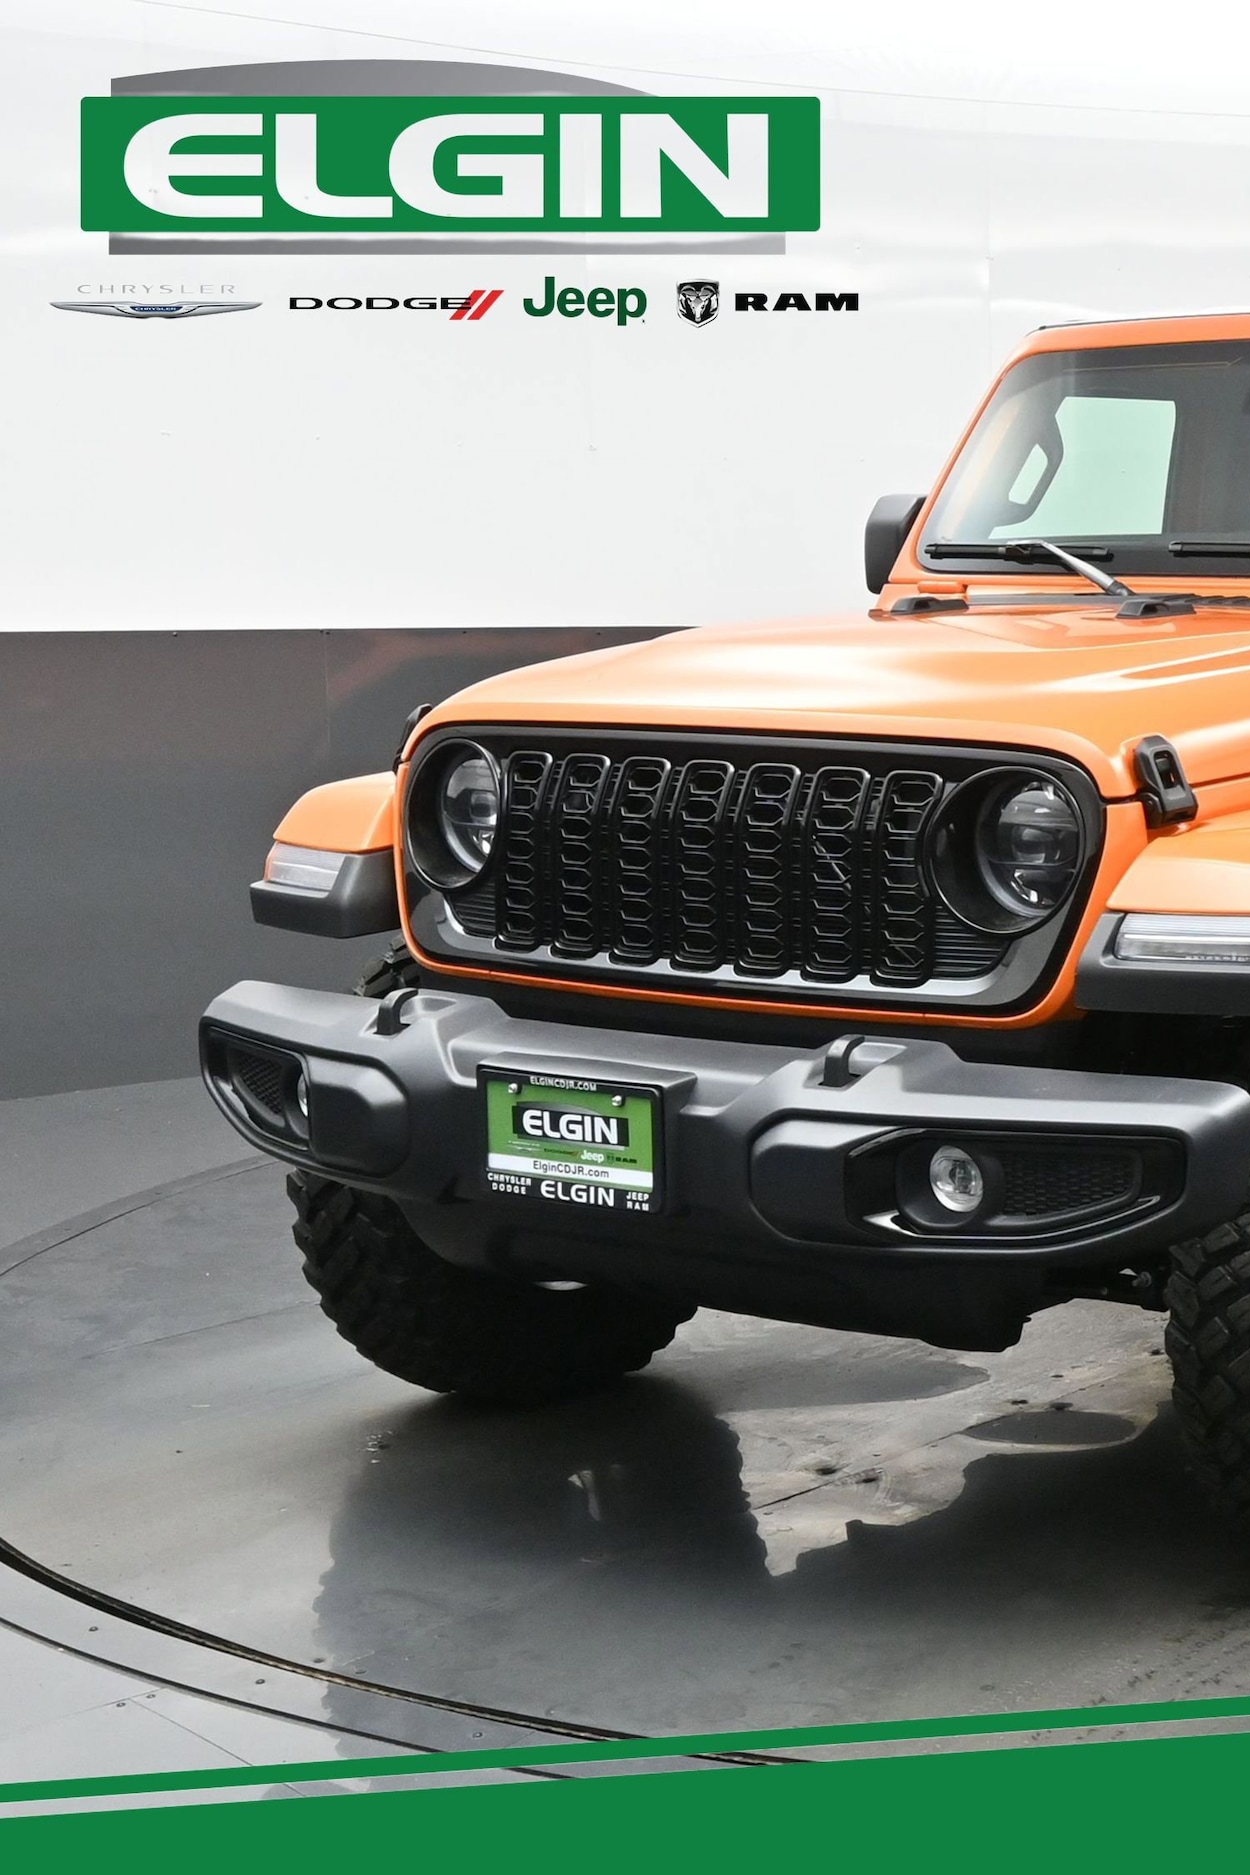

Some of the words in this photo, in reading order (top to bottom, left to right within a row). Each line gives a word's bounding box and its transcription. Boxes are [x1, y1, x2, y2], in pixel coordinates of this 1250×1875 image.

[530, 1076, 597, 1091] ELGINCDJR.COM
[522, 1109, 618, 1145] ELGIN
[581, 1150, 604, 1163] Jeep
[533, 1160, 610, 1178] ElginCDJR.com
[487, 1172, 532, 1186] CHRYSLER
[492, 1183, 527, 1195] DODGE
[540, 1180, 614, 1206] ELGIN
[626, 1191, 650, 1201] JEEP
[626, 1202, 650, 1212] RAM
